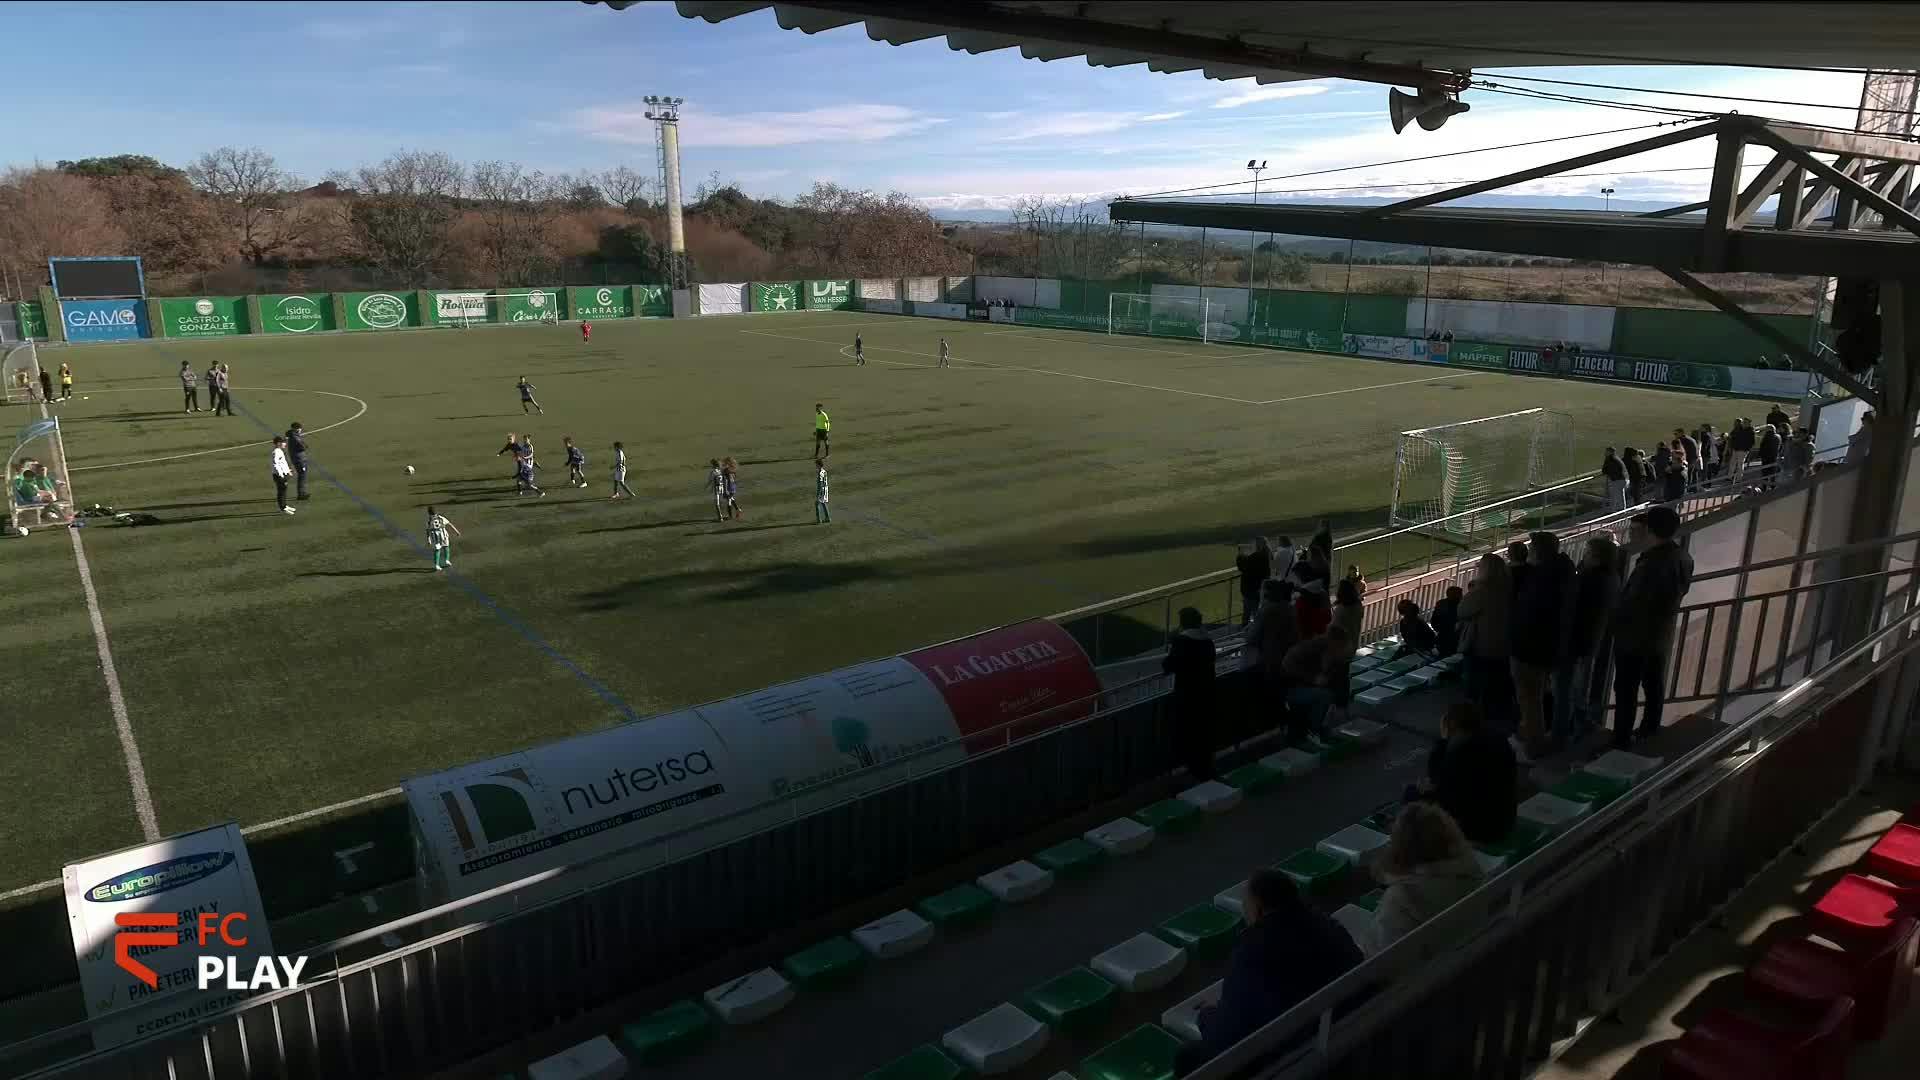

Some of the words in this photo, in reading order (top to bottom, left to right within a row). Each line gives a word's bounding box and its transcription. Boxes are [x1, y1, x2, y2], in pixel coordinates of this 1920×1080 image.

[68, 309, 136, 326] GAMO
[286, 306, 311, 315] Isidro
[577, 306, 632, 315] CARRASCO
[178, 316, 220, 324] CASTRO
[1459, 353, 1503, 364] MAPFRE
[1509, 351, 1538, 370] FUTUR
[1575, 356, 1615, 372] TERCERA
[1634, 360, 1669, 383] FUTUR
[929, 664, 975, 688] LA
[968, 640, 1057, 675] GACETA
[562, 750, 714, 815] nutersa
[92, 850, 225, 900] Europillow
